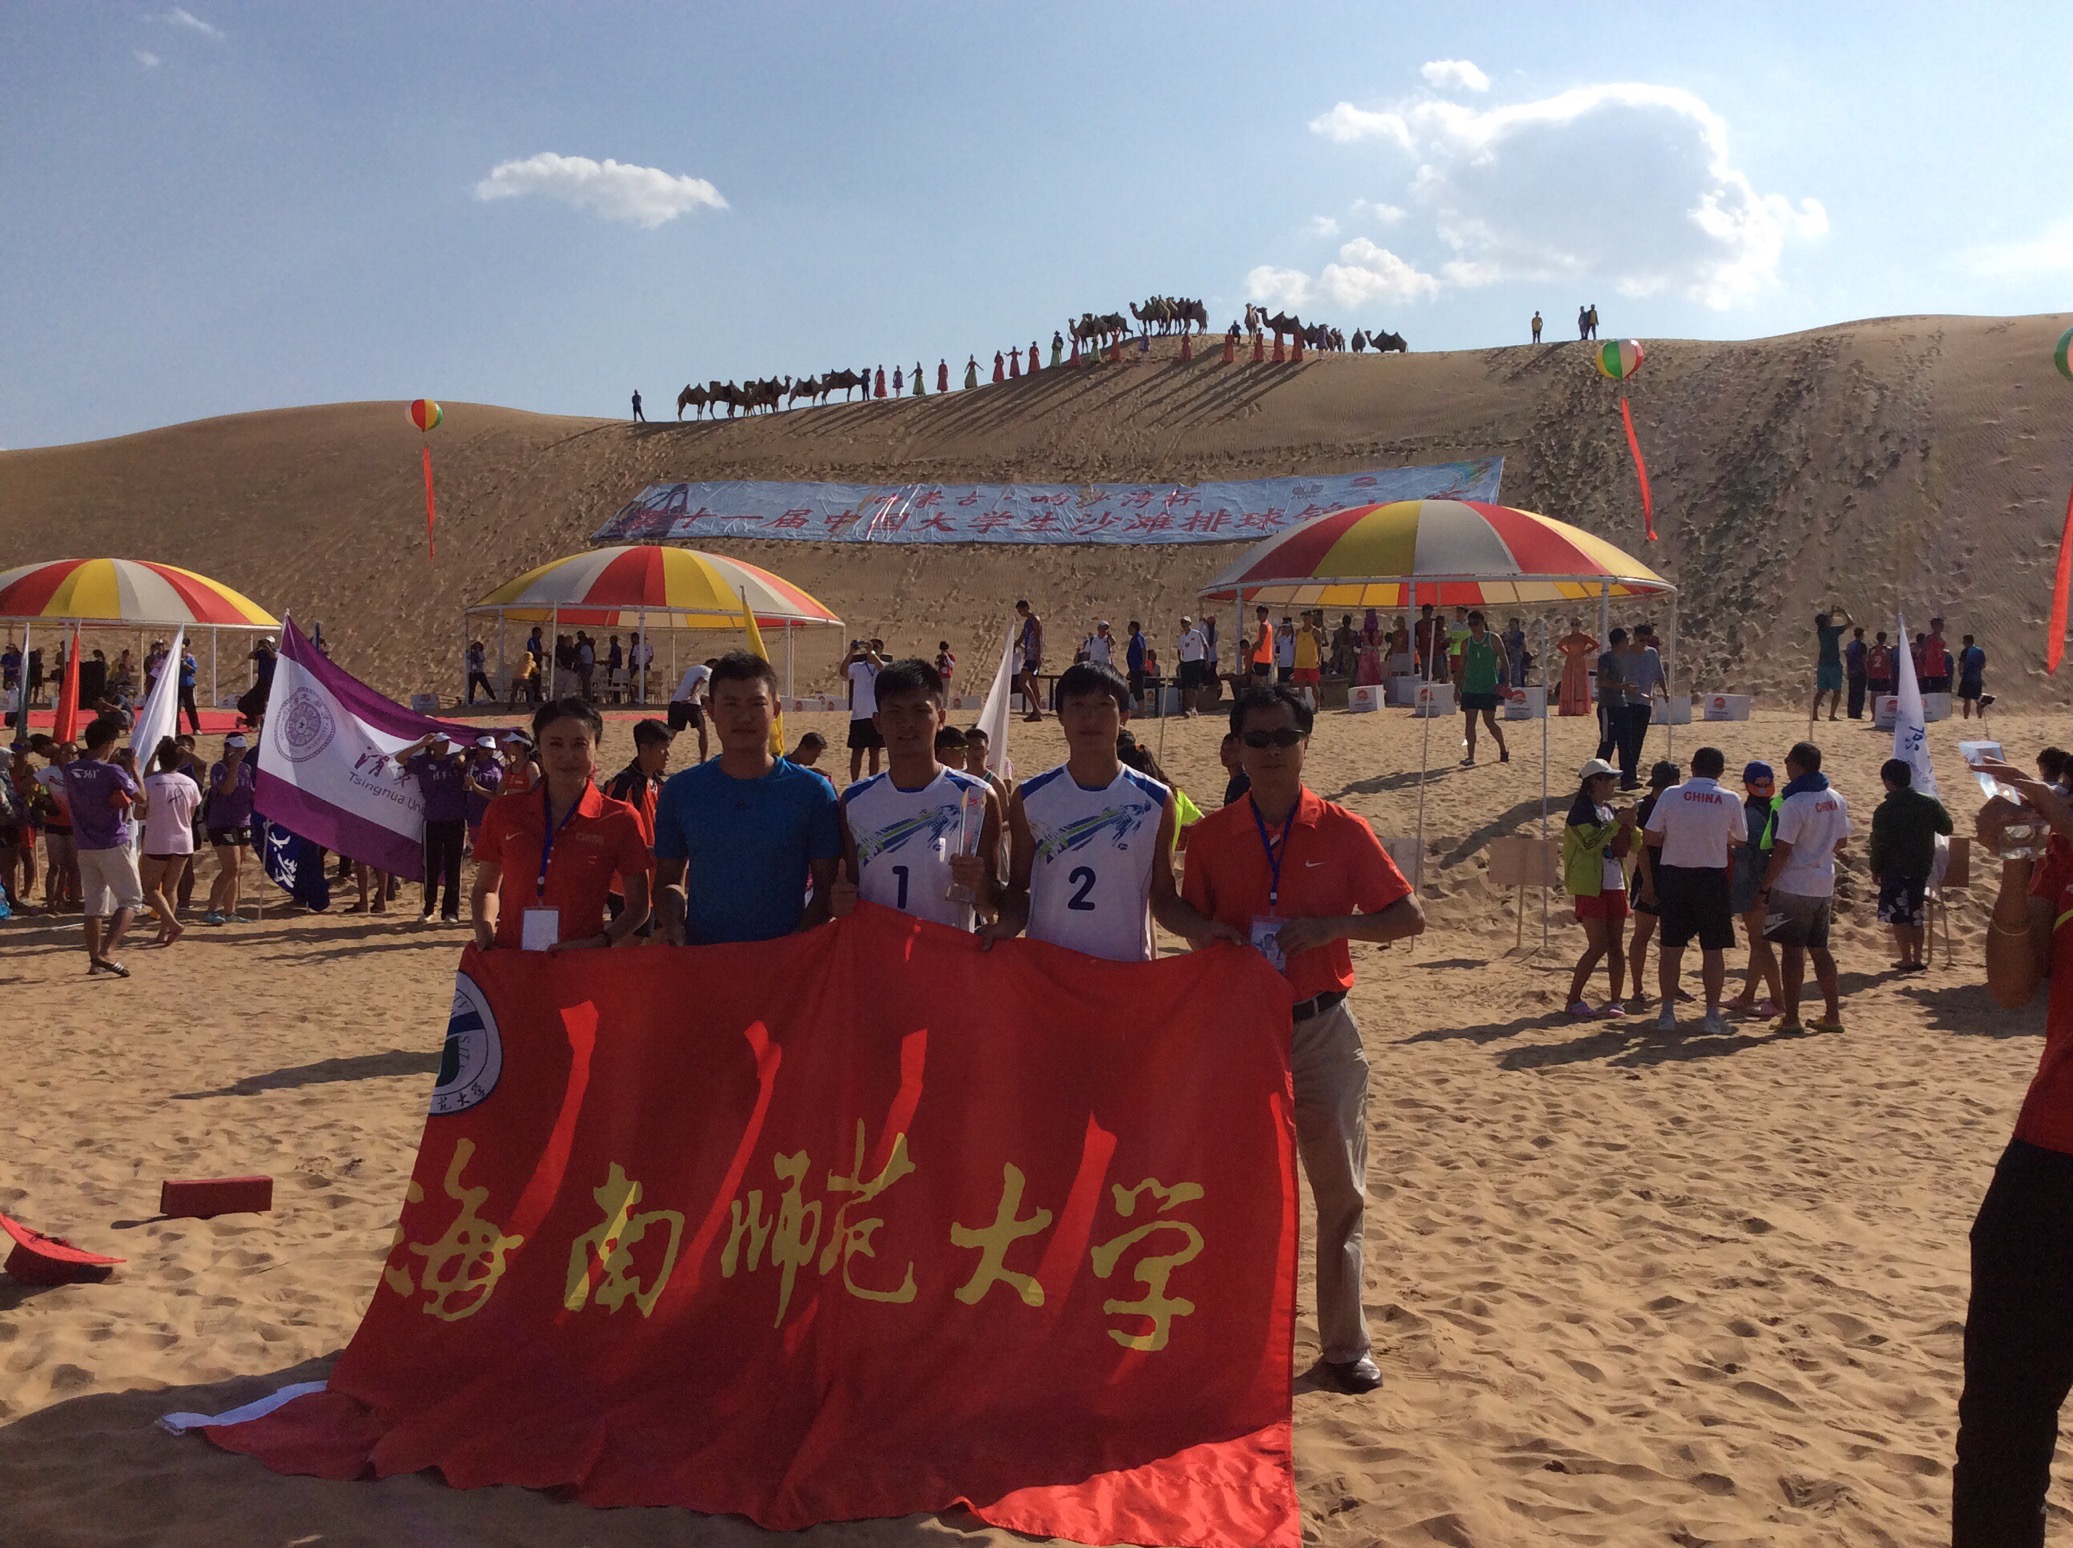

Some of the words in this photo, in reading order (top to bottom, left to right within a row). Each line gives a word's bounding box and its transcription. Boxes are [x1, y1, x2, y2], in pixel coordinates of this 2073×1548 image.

[1873, 655, 1883, 668] 2
[1683, 790, 1724, 806] CHINA
[1815, 800, 1840, 814] CHINA
[892, 865, 909, 910] 1
[1067, 865, 1097, 911] 2
[385, 1117, 1205, 1351] 海南师范大学
